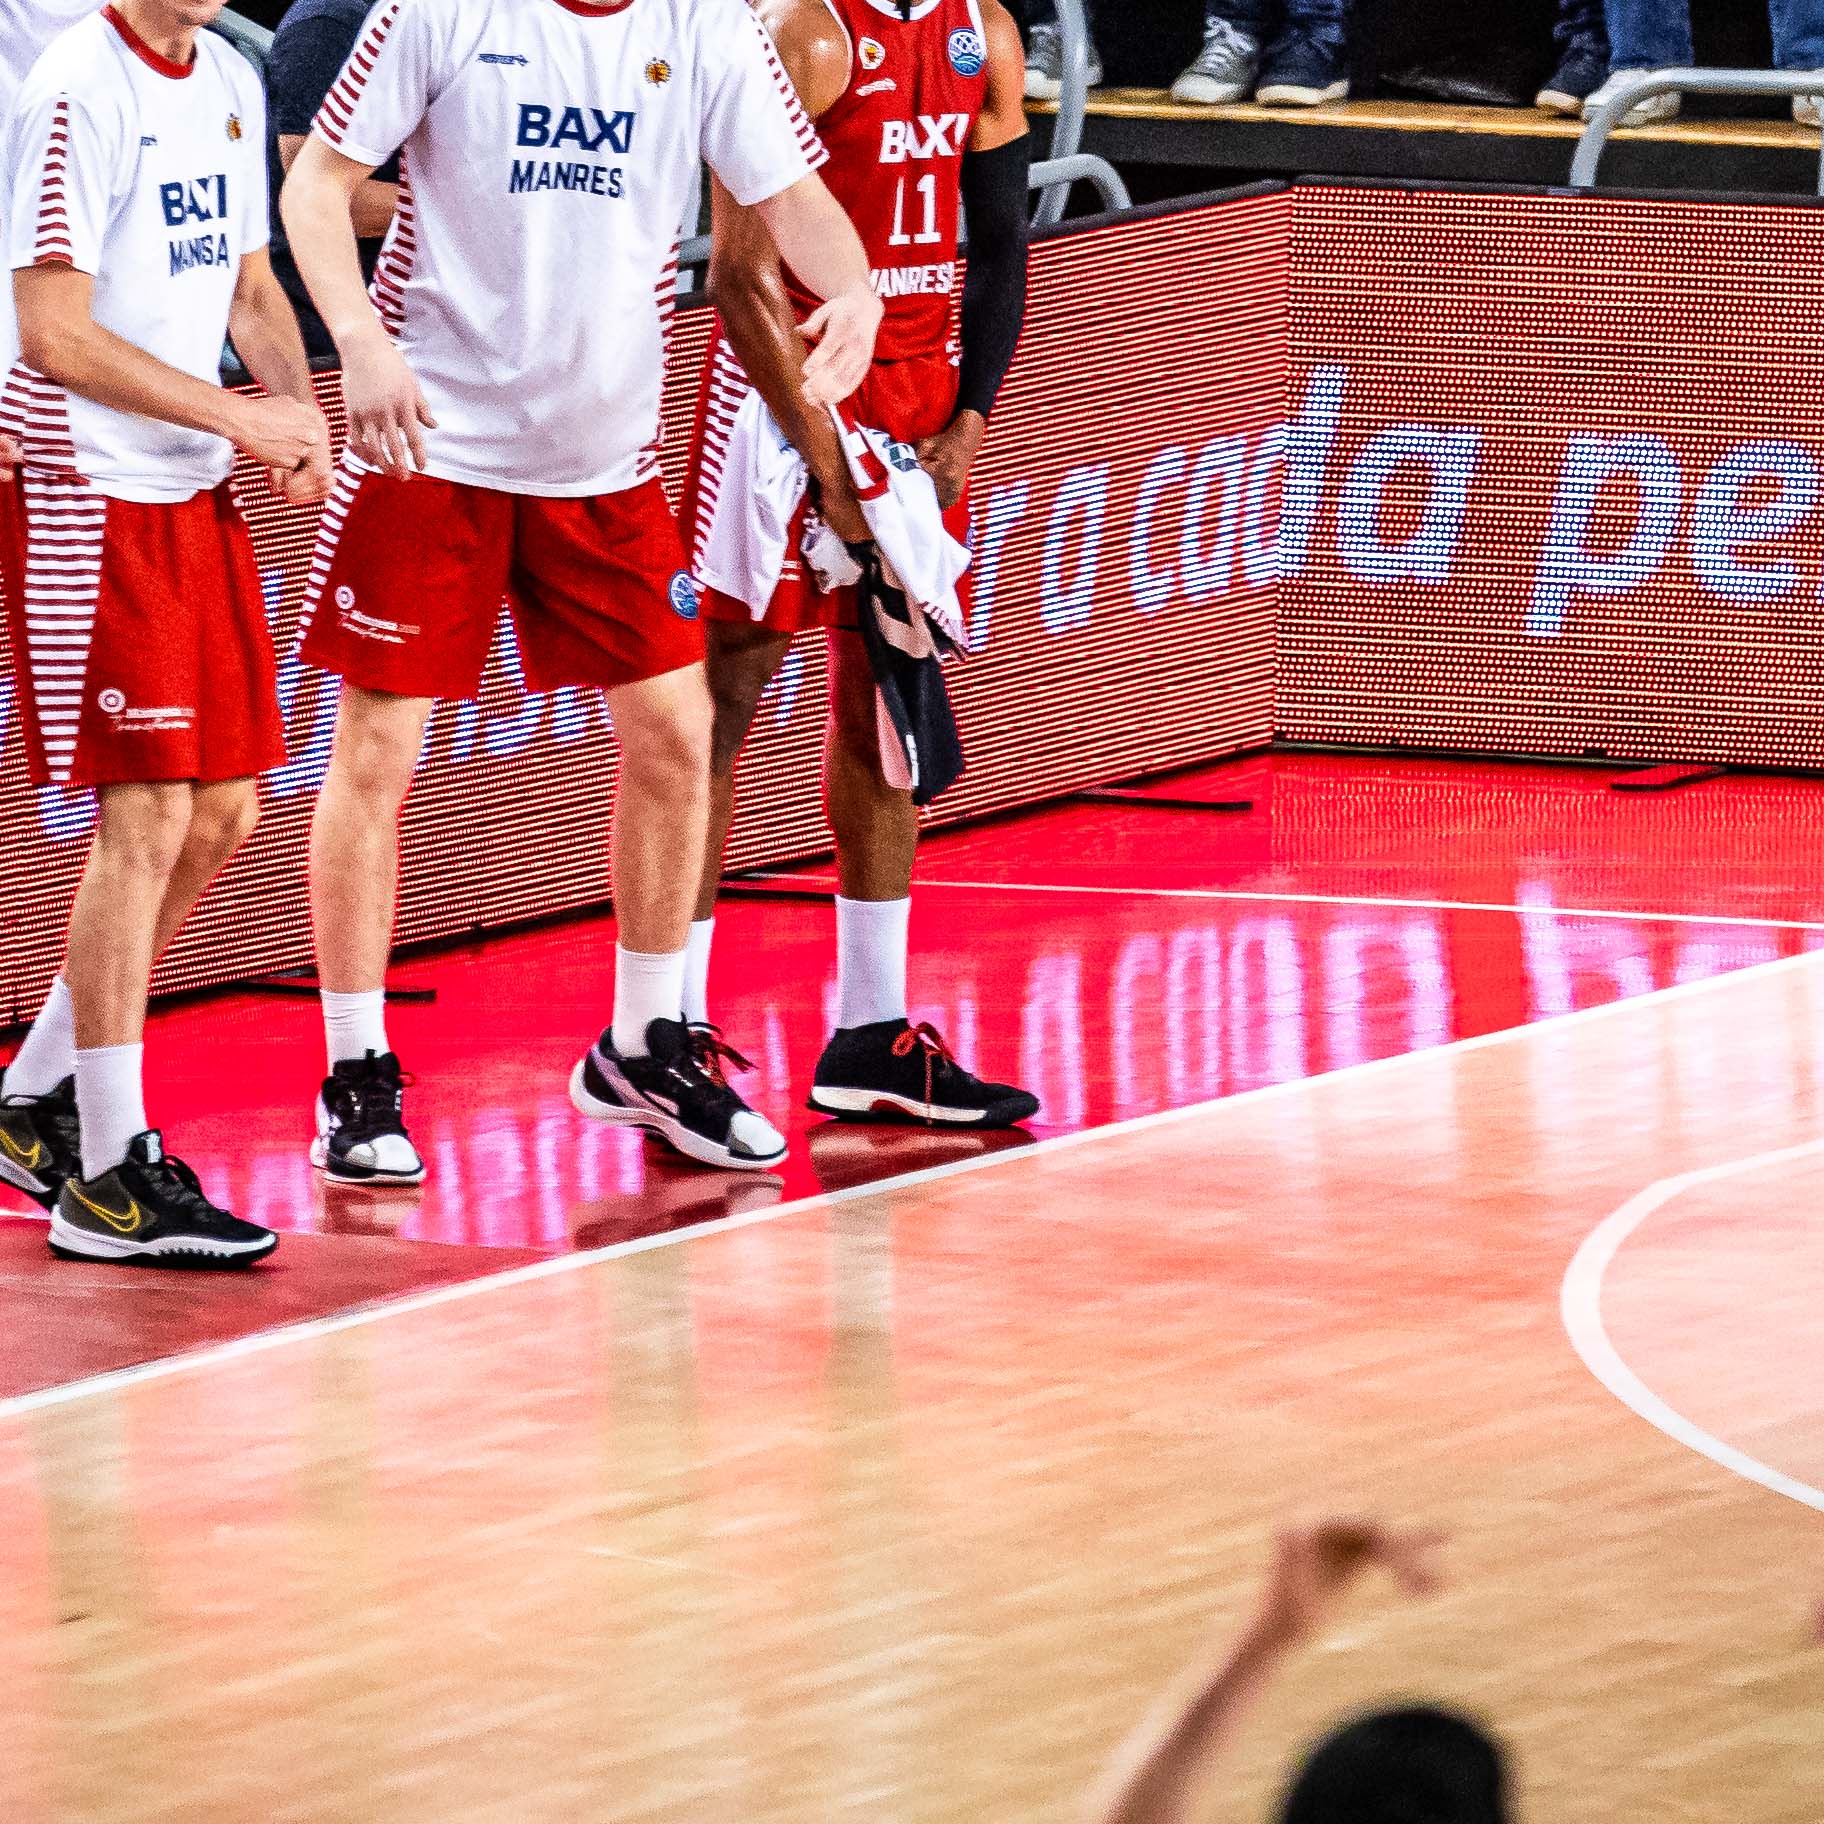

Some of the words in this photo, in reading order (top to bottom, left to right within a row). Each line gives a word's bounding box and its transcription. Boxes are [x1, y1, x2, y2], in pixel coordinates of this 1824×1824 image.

[517, 103, 638, 156] BAXI
[878, 113, 971, 164] BAXI
[509, 159, 626, 200] MANRES
[888, 176, 948, 248] 11
[1131, 362, 1482, 613] cada
